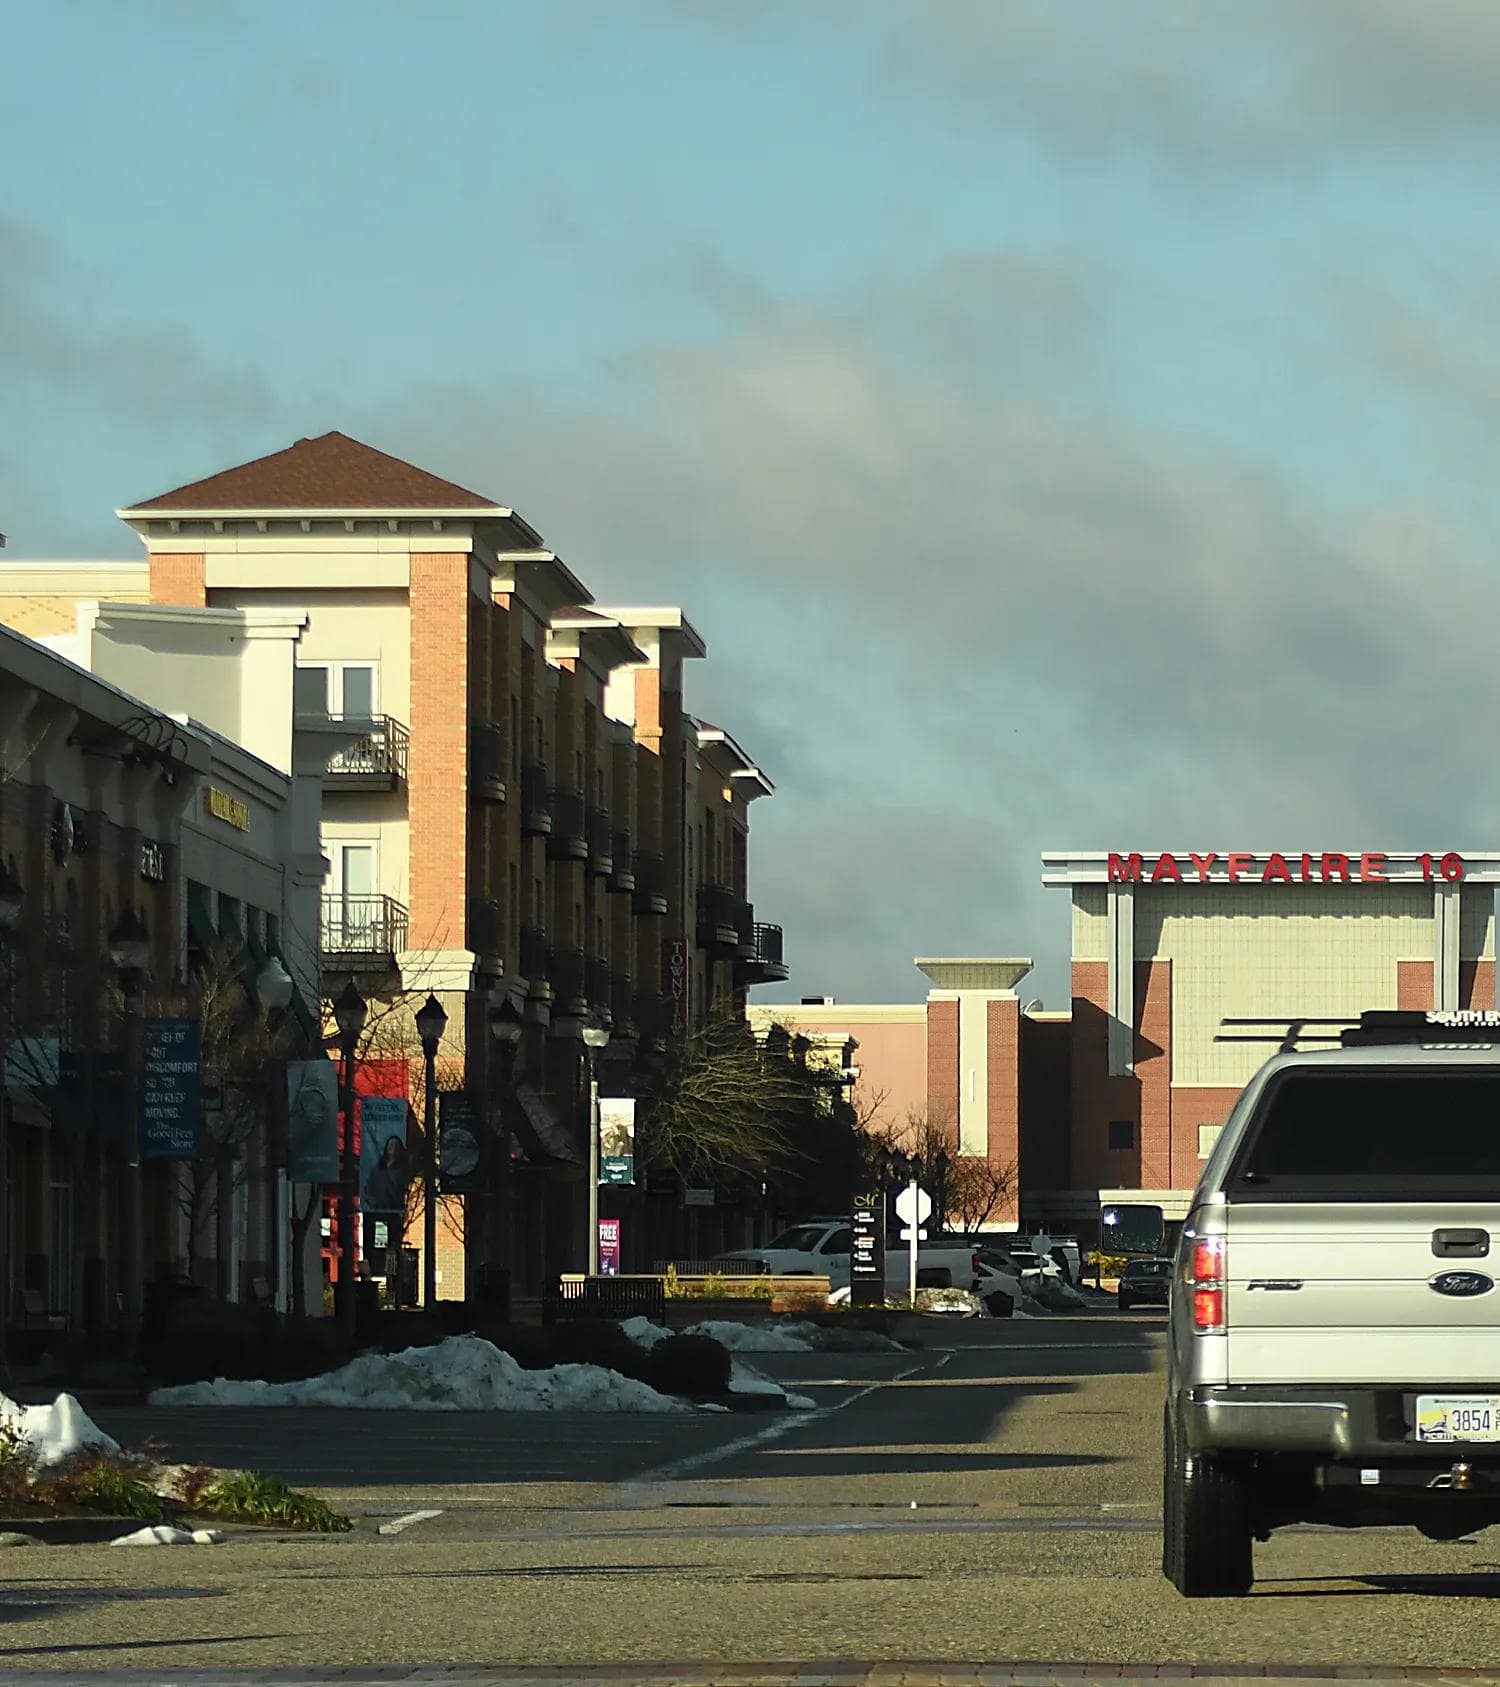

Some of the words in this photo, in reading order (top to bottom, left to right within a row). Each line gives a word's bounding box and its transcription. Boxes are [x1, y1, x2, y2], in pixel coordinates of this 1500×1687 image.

[1107, 852, 1387, 882] MAYFAIRE
[1415, 852, 1464, 882] 16
[1425, 1010, 1483, 1024] SOUTH
[146, 1062, 199, 1074] DISCOMFORT
[147, 1128, 175, 1140] Good
[599, 1223, 617, 1241] FREE
[1442, 1275, 1480, 1292] Ford
[1452, 1409, 1490, 1432] 3854
